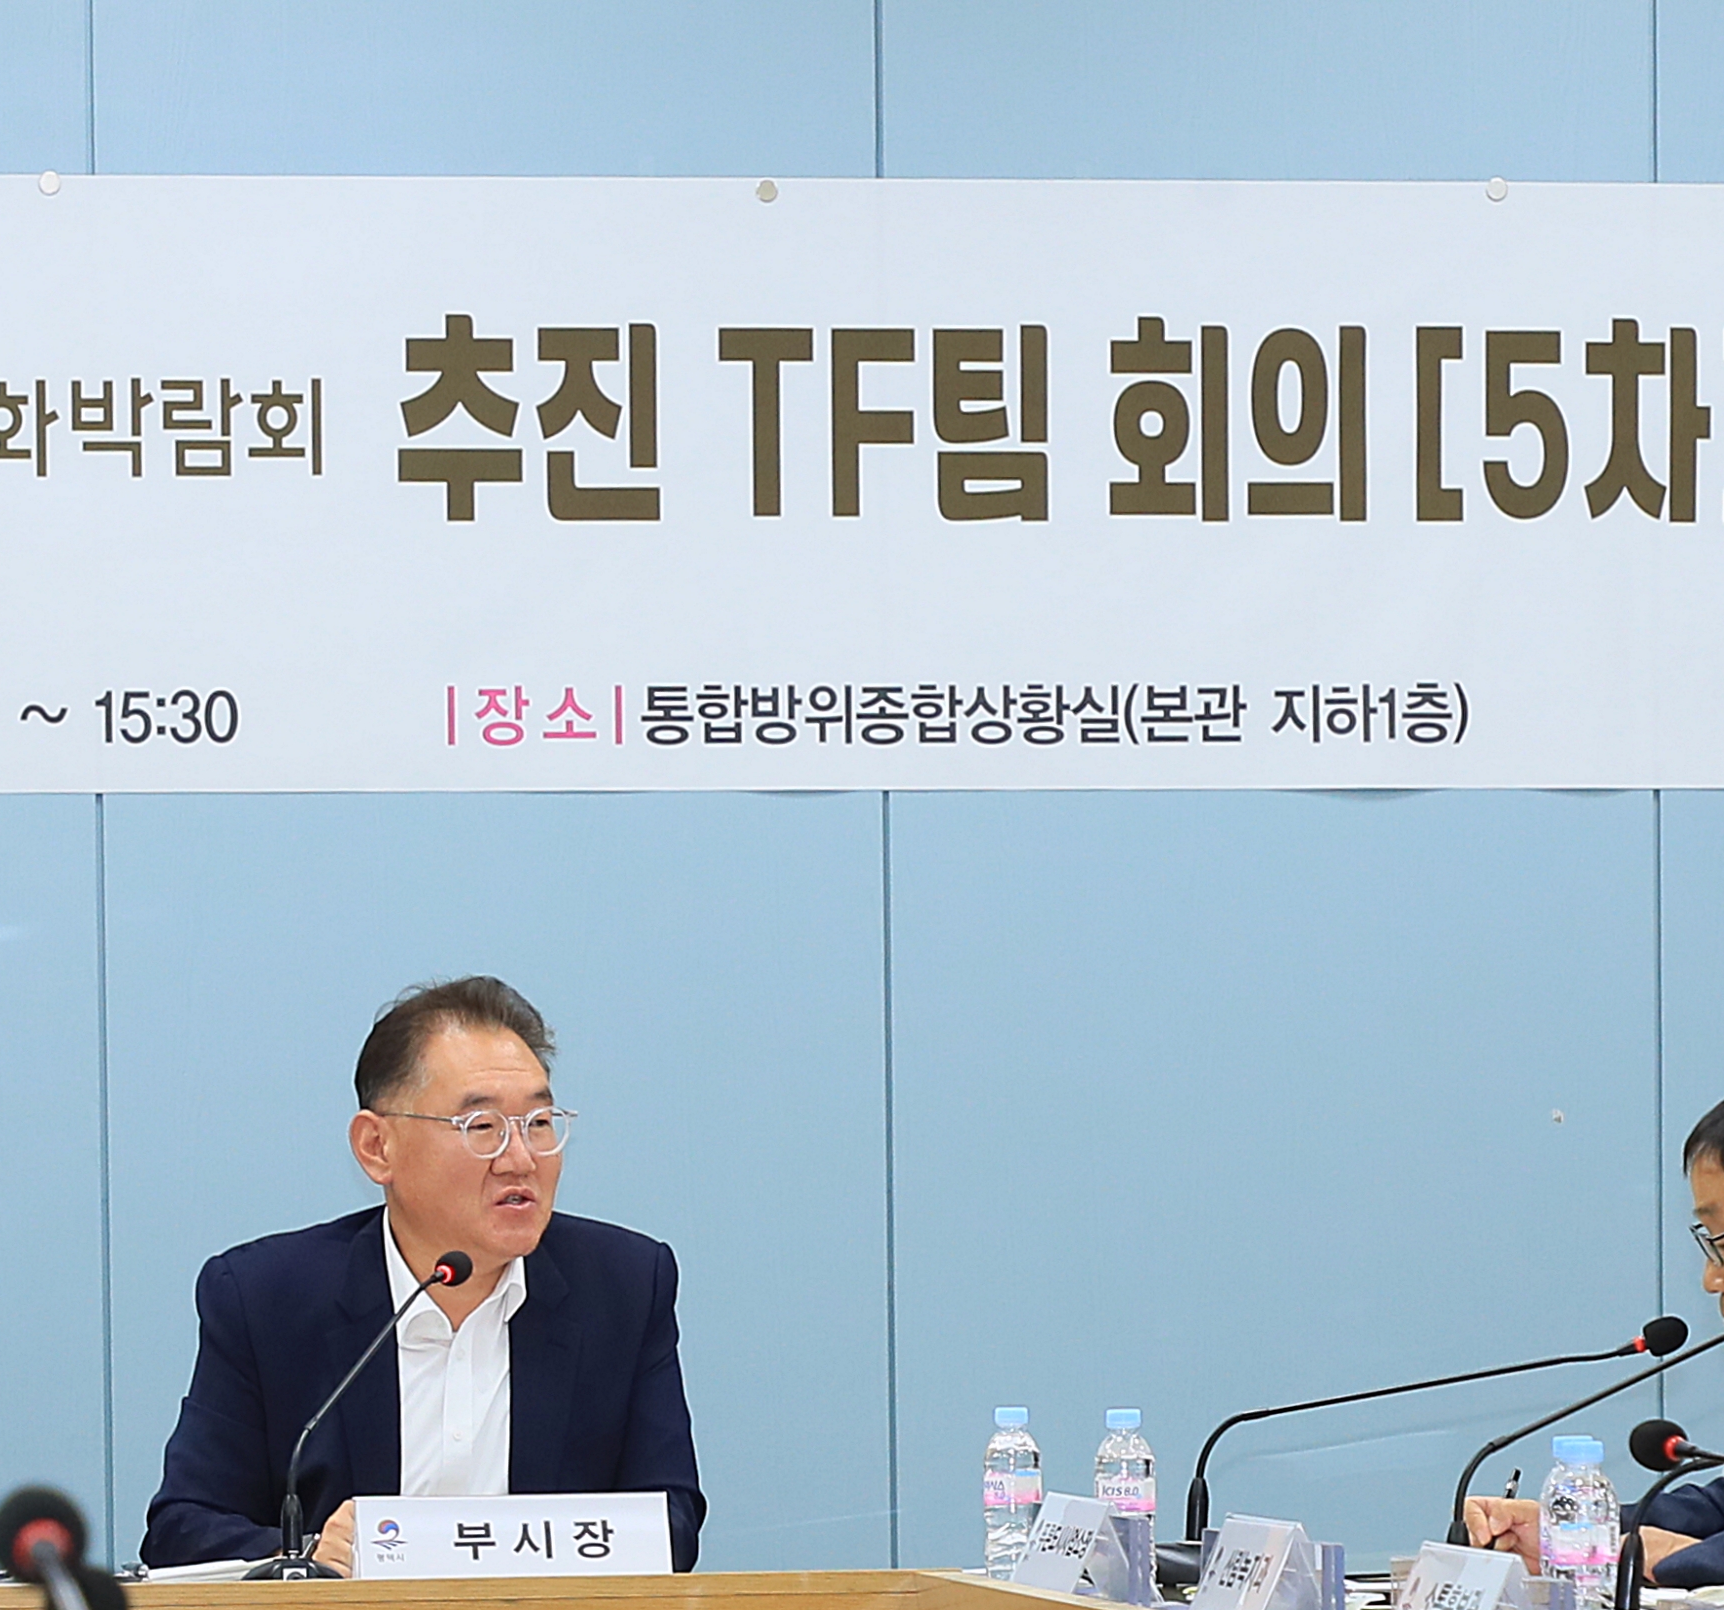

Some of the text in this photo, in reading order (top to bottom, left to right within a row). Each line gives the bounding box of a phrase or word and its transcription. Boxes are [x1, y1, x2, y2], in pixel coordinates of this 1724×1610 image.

[397, 313, 662, 523] 추진
[717, 323, 1050, 523] TF팀
[1108, 315, 1368, 523] 회의
[94, 689, 239, 745] 15:30
[640, 682, 1248, 746] 통합방위종합상황실(본관
[1271, 681, 1469, 745] 지하1층)
[453, 1519, 616, 1561] 부시장
